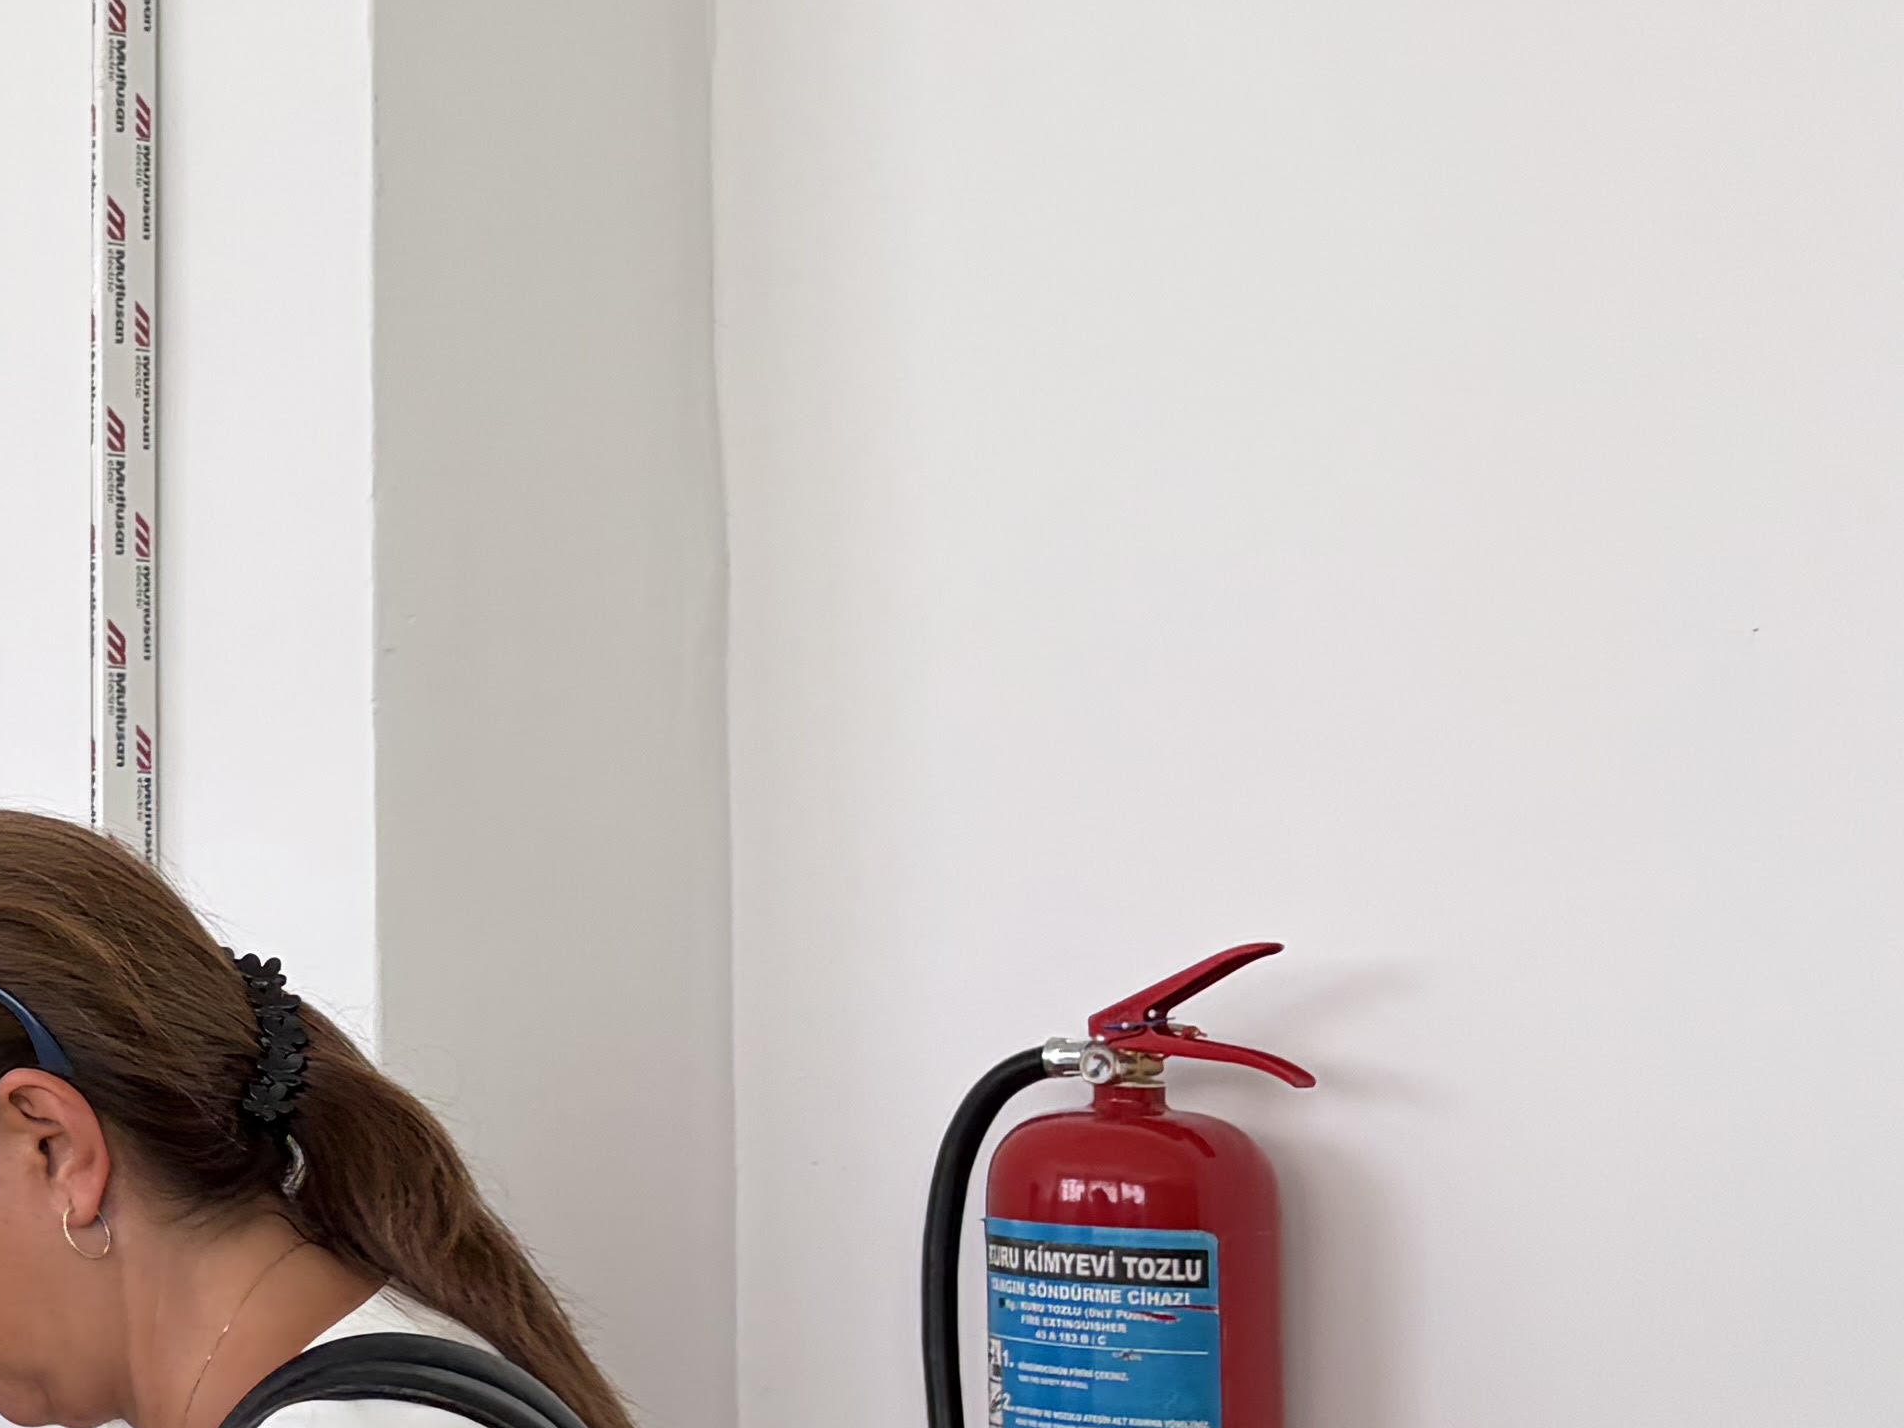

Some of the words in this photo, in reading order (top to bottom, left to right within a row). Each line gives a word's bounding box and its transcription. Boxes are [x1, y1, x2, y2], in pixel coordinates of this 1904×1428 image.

[115, 39, 126, 134] Mutlusan
[114, 248, 125, 345] Mutlusan
[115, 459, 125, 557] Mutlusan
[115, 671, 125, 768] Mutlusan
[1024, 1244, 1115, 1279] KİMYEVİ
[1122, 1256, 1203, 1283] TOZLU
[1028, 1279, 1122, 1305] SÖNDÜRME
[1097, 1335, 1107, 1346] C
